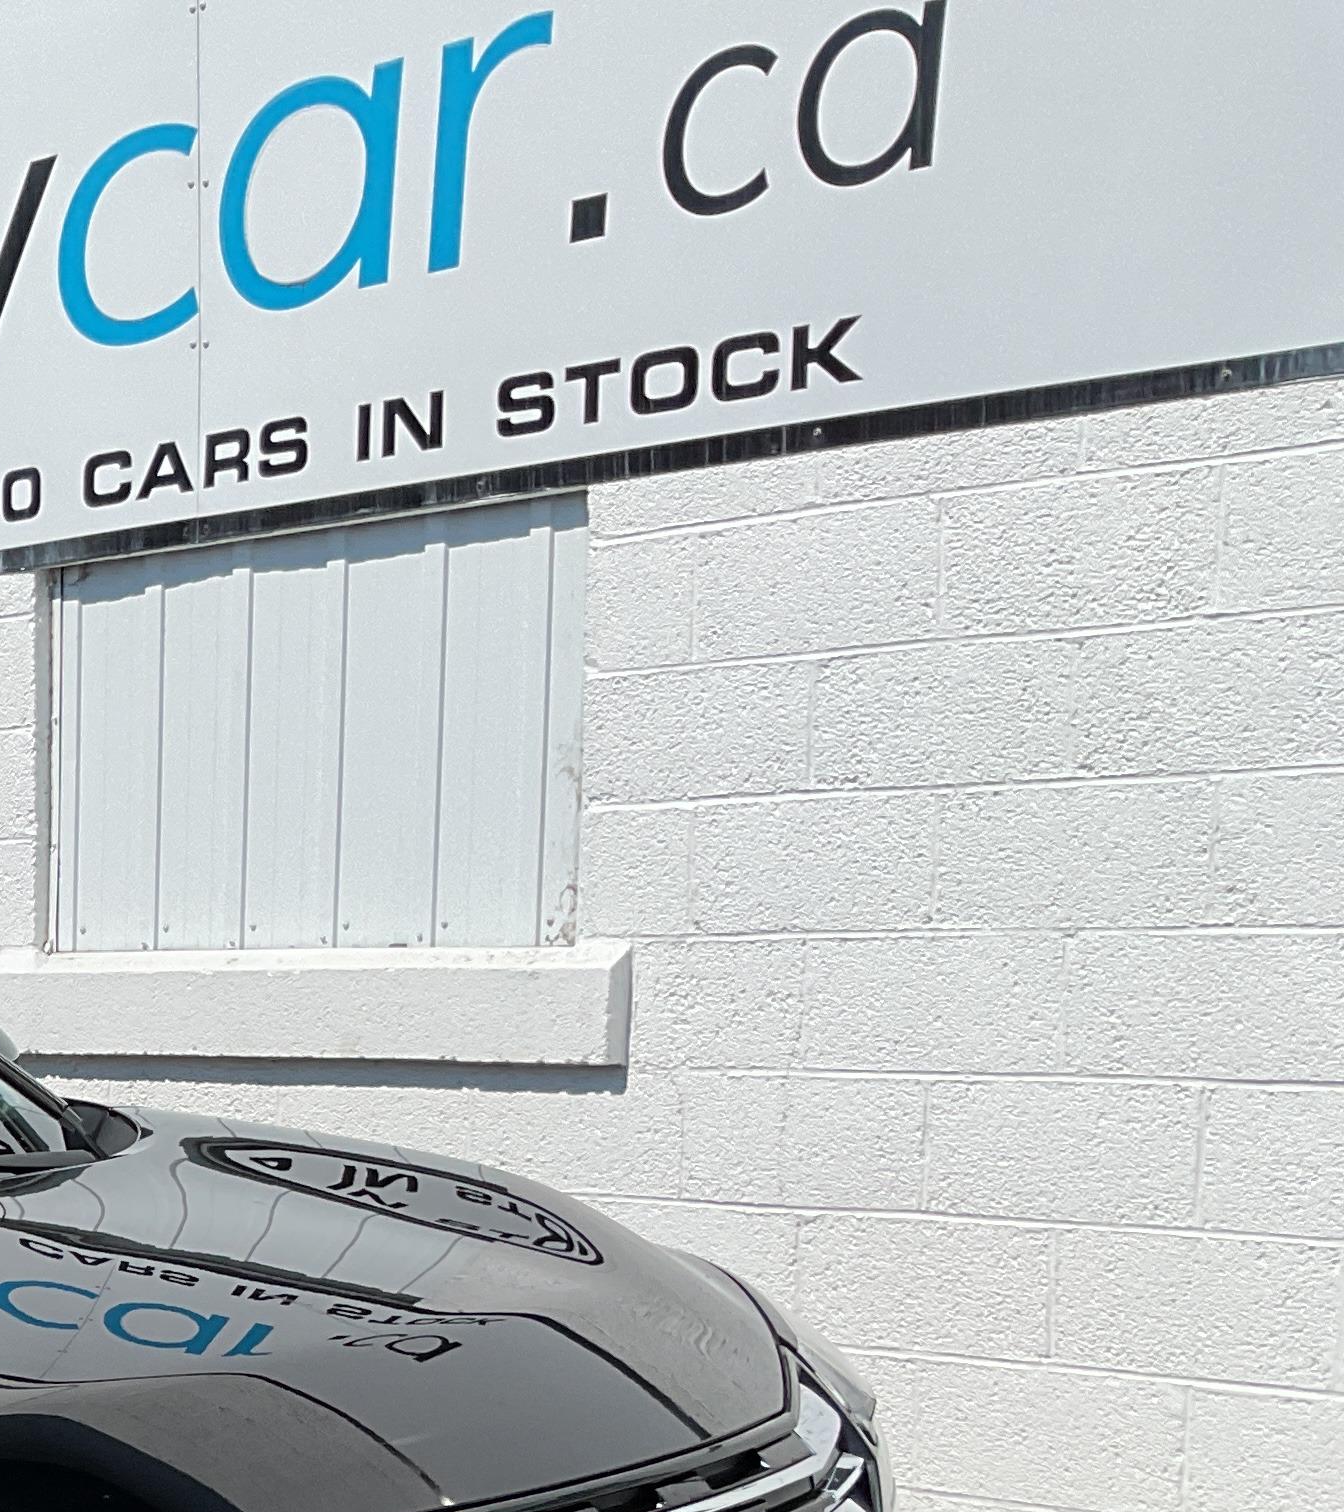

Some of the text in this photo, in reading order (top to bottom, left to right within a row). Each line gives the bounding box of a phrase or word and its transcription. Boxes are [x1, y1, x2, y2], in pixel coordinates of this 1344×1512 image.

[82, 417, 310, 508] CARS
[355, 390, 446, 462] IN
[495, 314, 864, 438] STOCK
